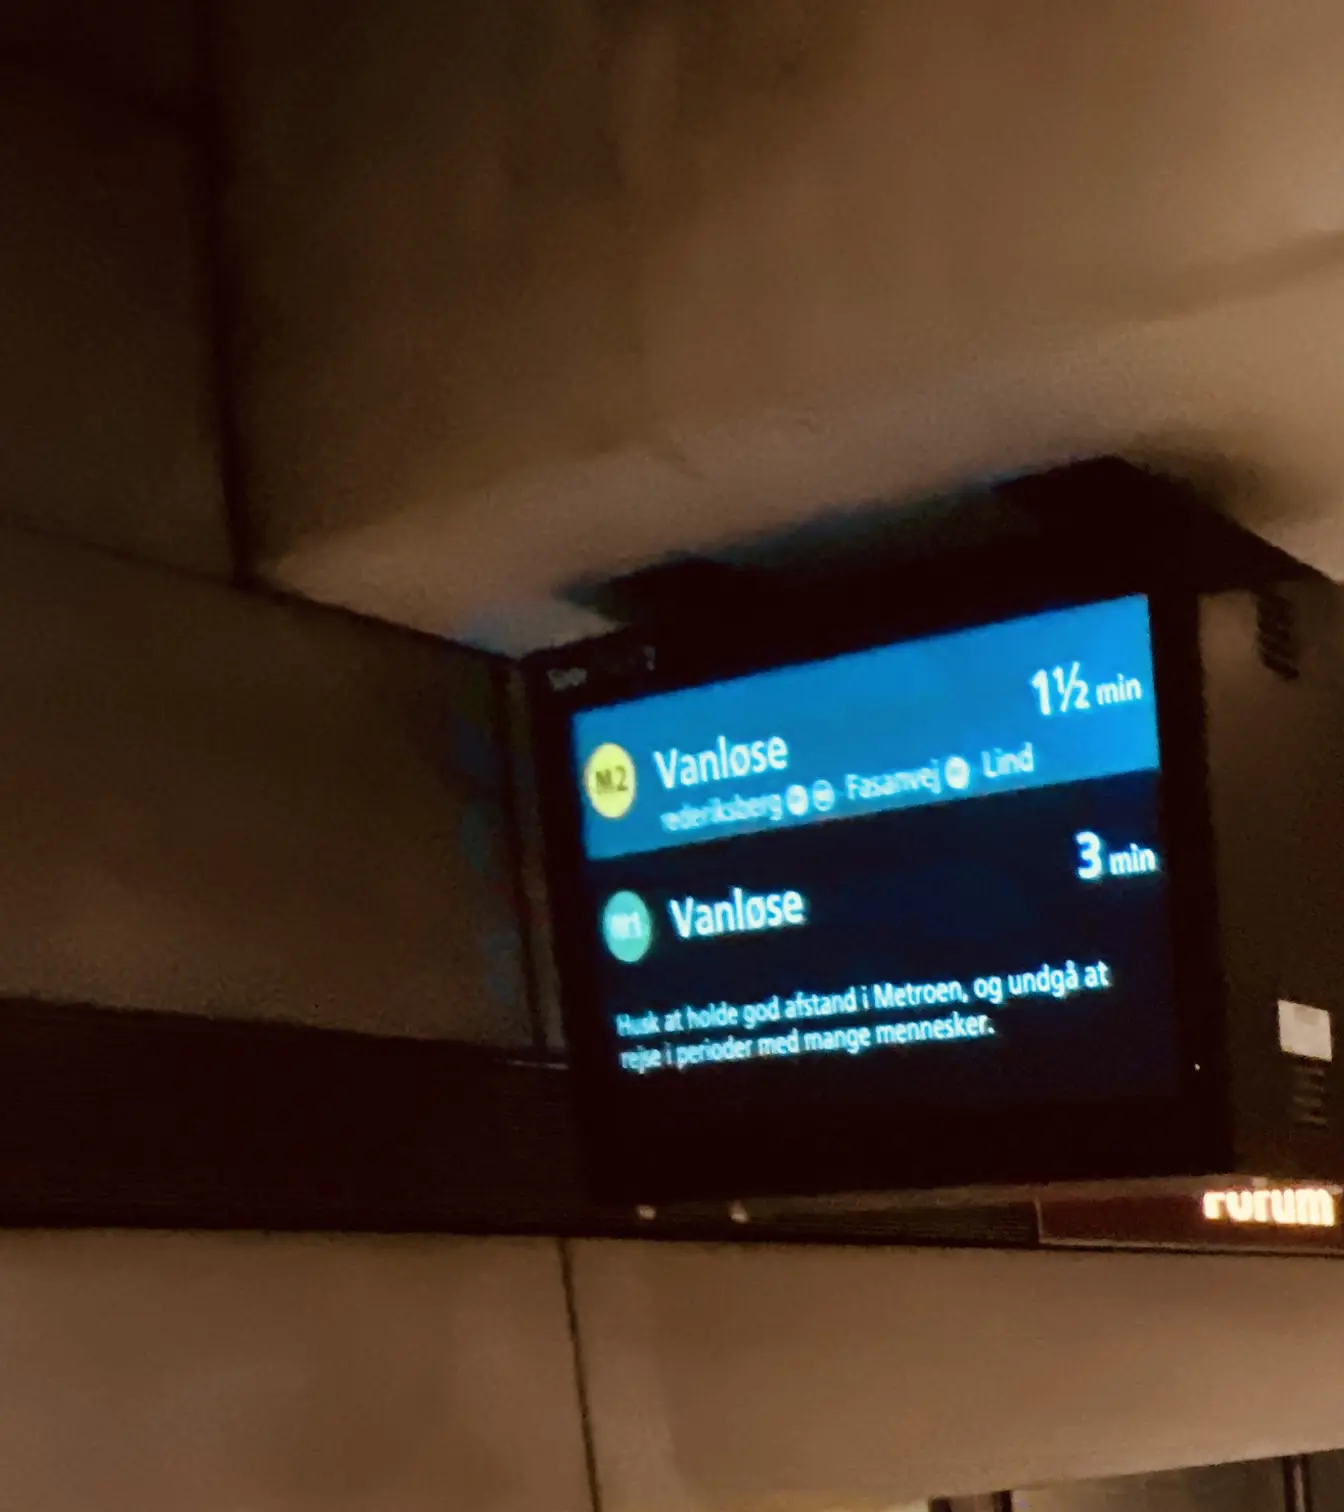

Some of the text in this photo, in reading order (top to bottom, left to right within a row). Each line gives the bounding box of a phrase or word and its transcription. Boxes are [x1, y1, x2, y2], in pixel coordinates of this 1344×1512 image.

[1096, 673, 1143, 705] min
[595, 765, 629, 794] M2
[653, 734, 788, 789] Vanløse
[1076, 831, 1157, 878] 3 min
[669, 886, 805, 938] Vanløse
[615, 960, 1110, 1036] Husk at holde god afstand i Metroen, og undgå at
[663, 1042, 673, 1066] i
[676, 1034, 752, 1072] perioder
[757, 1027, 799, 1056] med
[804, 1026, 871, 1055] mange
[875, 1011, 996, 1045] mennesker.
